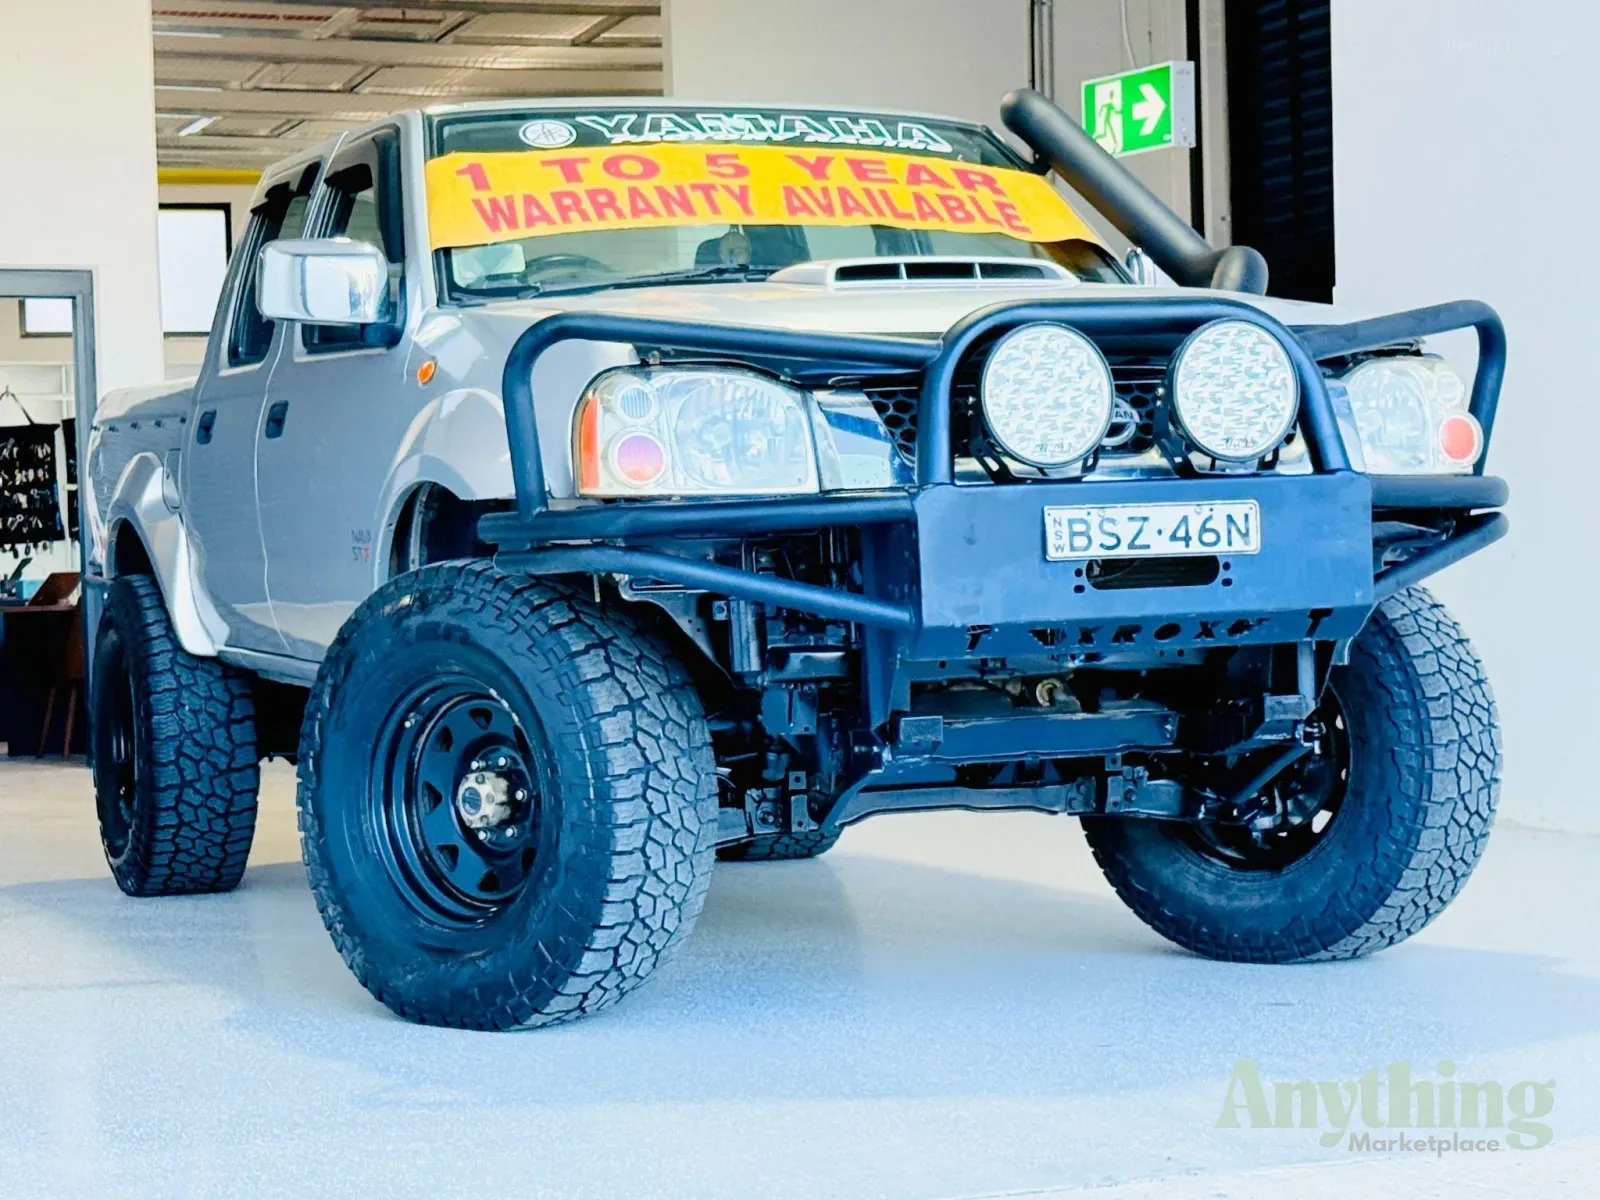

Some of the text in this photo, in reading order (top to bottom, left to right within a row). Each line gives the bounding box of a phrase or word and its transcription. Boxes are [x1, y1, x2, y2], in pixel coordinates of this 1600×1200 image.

[575, 113, 952, 150] YAMAHA
[456, 153, 1007, 197] 1 TO 5 YEAR
[471, 183, 1032, 234] WARRANTY AVAILABLE
